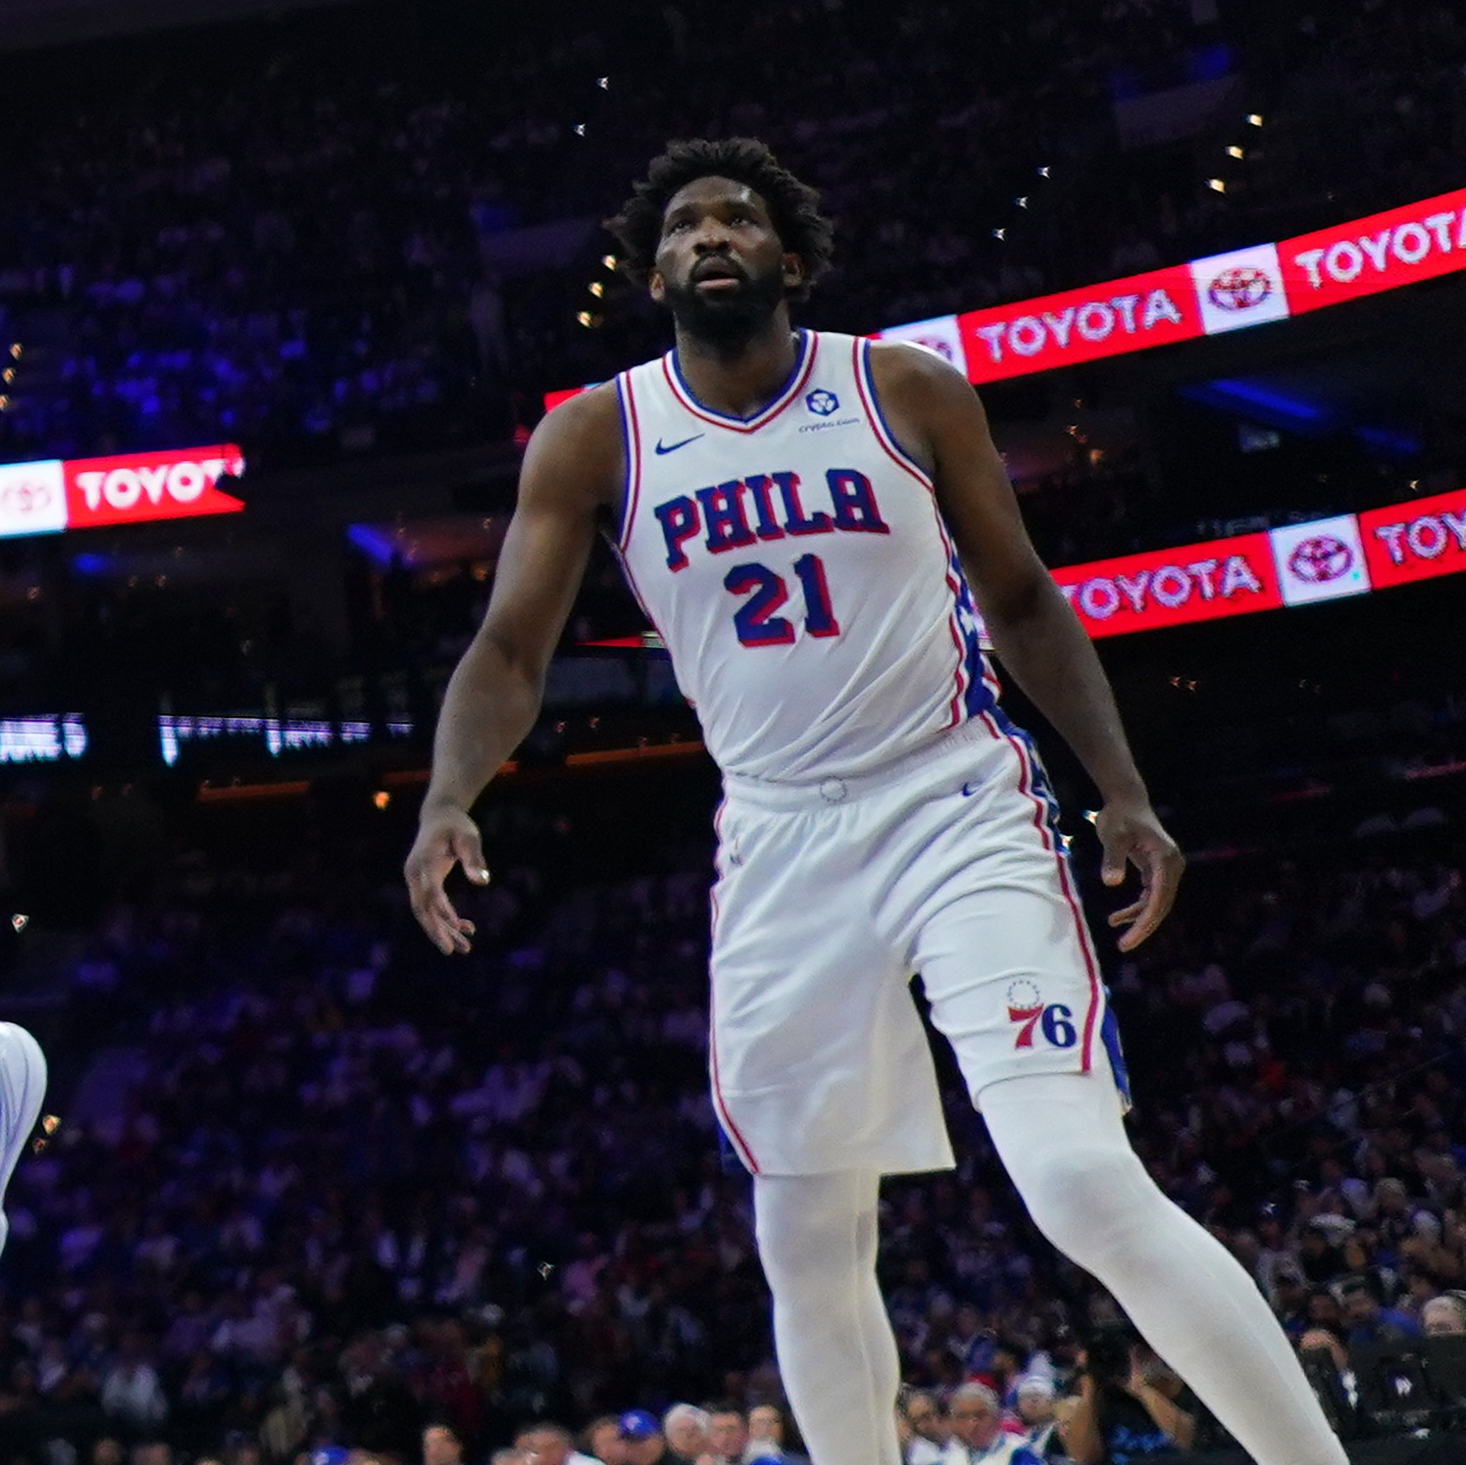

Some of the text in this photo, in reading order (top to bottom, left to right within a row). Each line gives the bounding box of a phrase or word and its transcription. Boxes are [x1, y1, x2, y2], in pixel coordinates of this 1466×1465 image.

[976, 208, 1466, 363] TOYOTA TOYOT
[653, 468, 891, 573] PHILA
[1375, 511, 1466, 567] TOY
[723, 553, 841, 649] 21
[1007, 1002, 1079, 1050] 76
